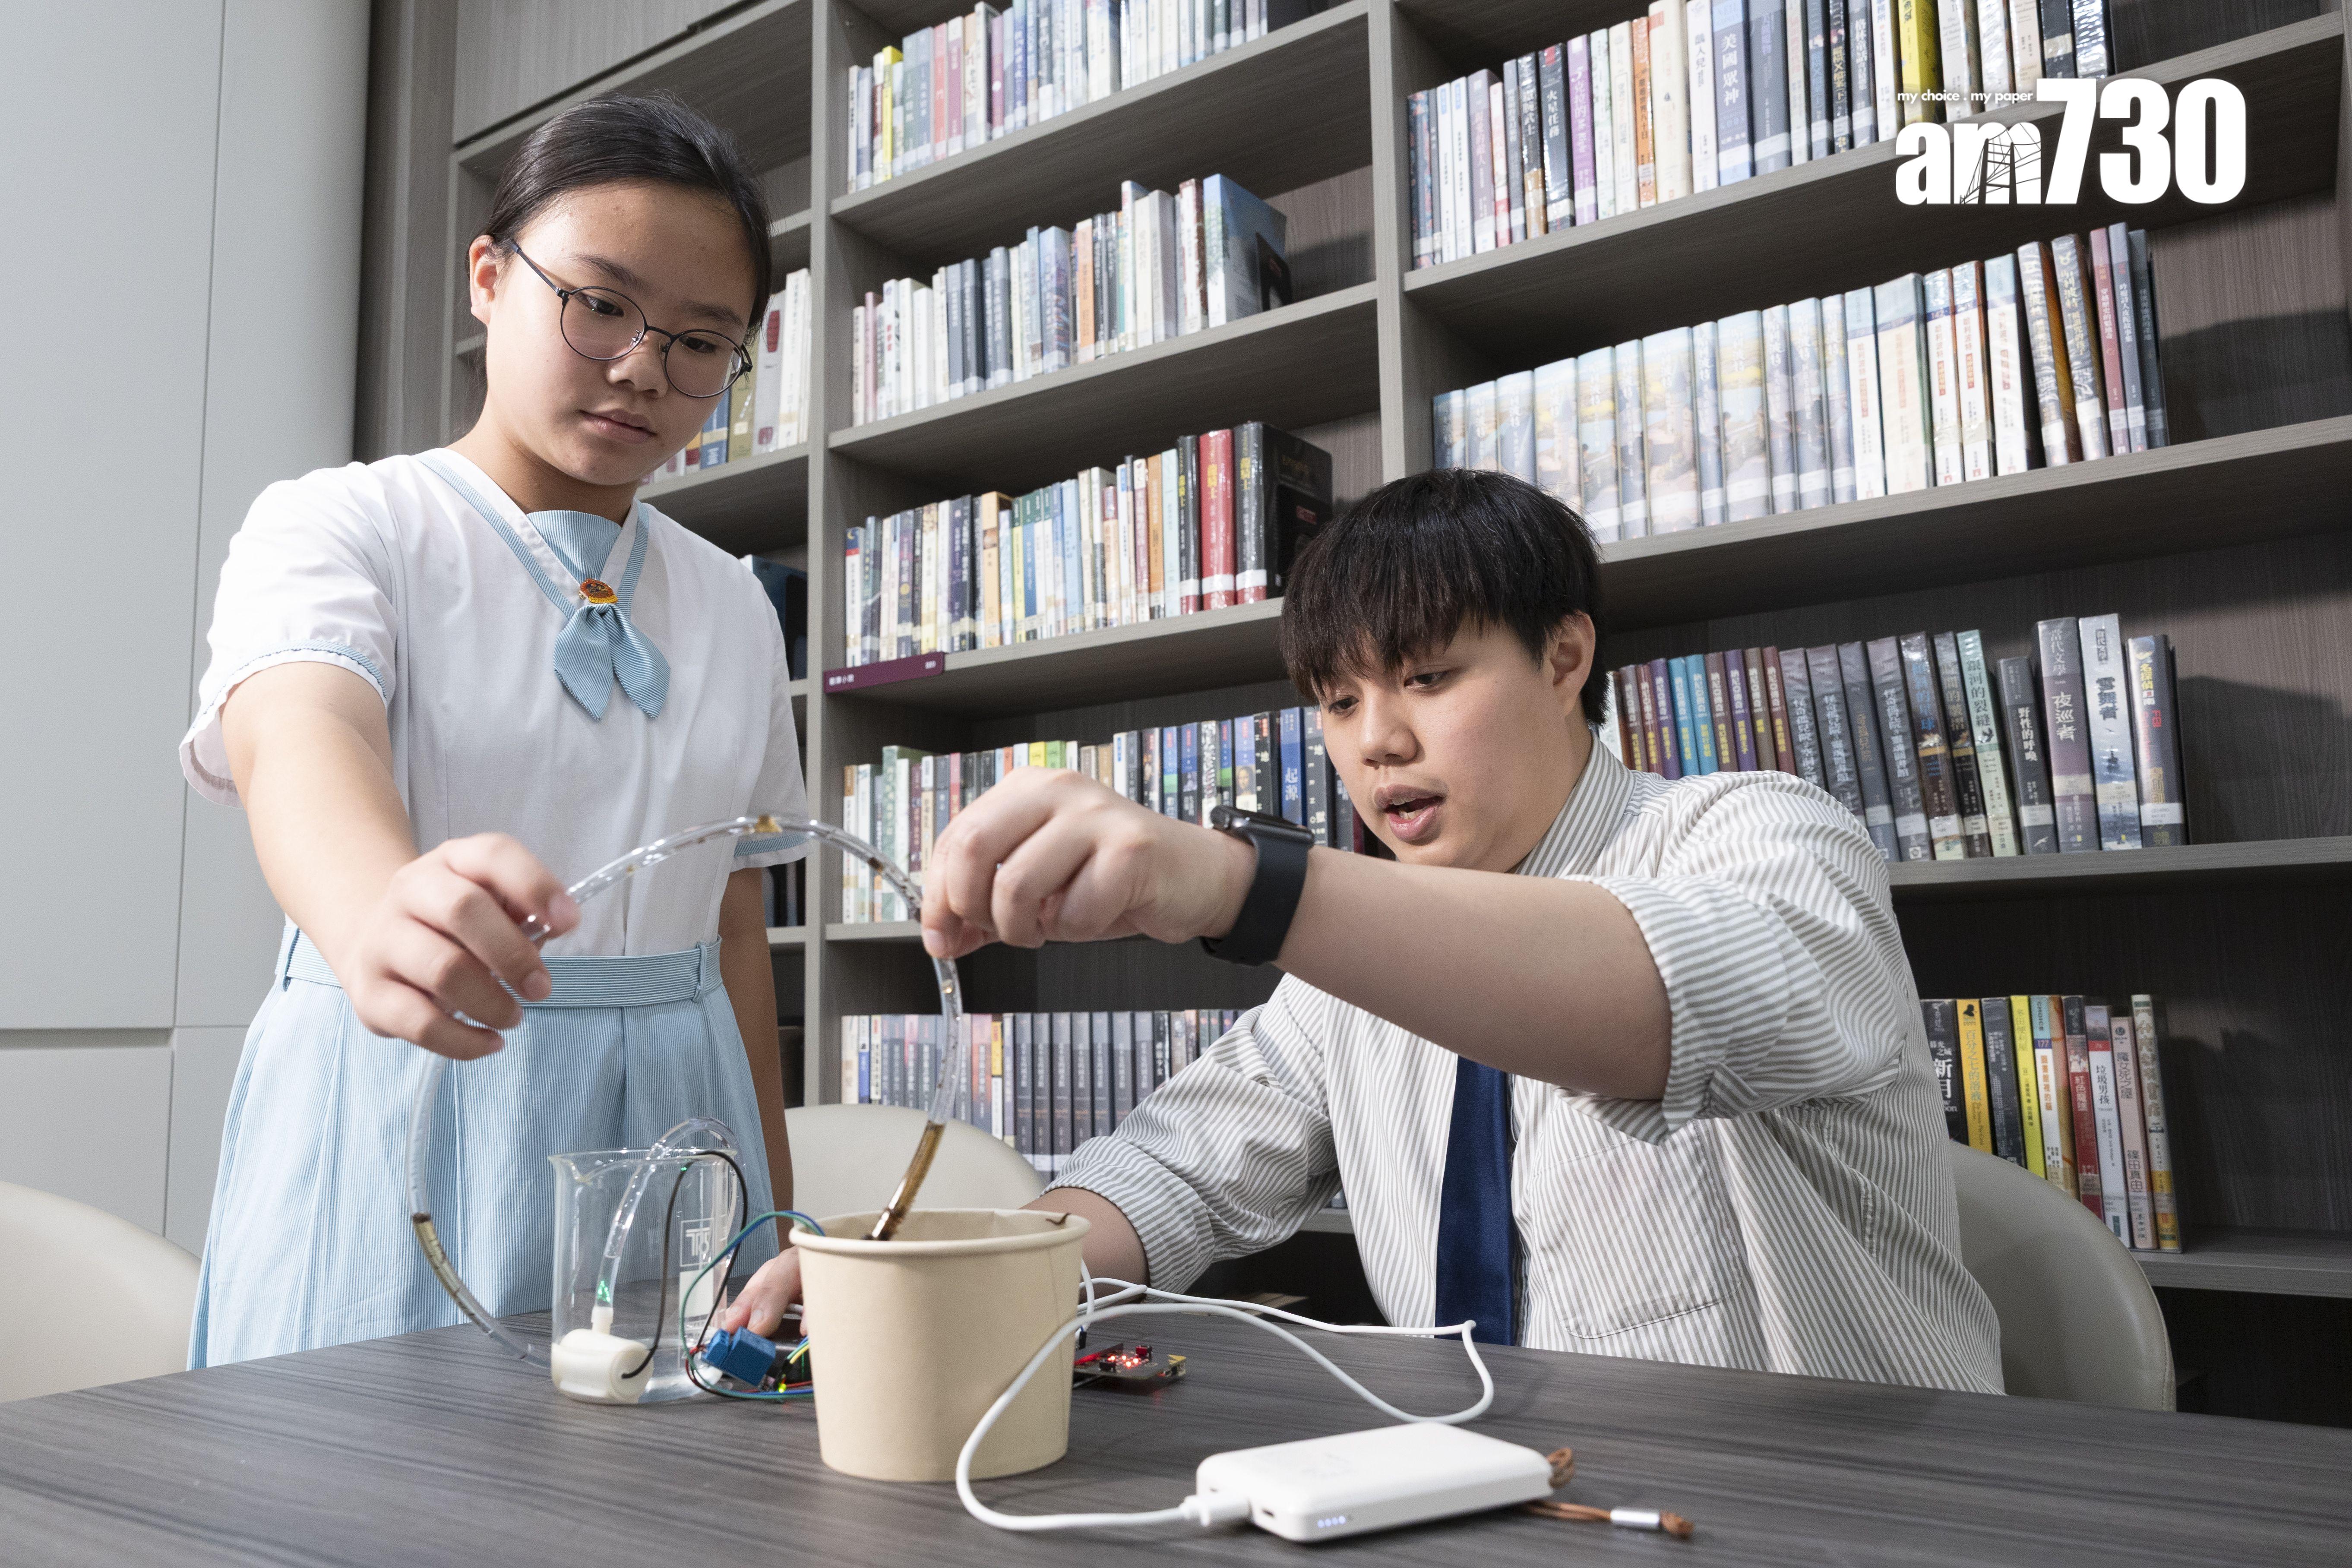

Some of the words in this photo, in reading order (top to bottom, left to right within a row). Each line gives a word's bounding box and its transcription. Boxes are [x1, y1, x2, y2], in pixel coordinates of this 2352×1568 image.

[1722, 34, 1739, 105] 美國眾神
[1546, 90, 1560, 138] 火星任務
[1965, 661, 1990, 727] 銀河的裂縫
[2052, 692, 2076, 743] 夜巡者
[2017, 707, 2037, 762] 野性的呼喚
[2152, 709, 2162, 728] FBI
[1285, 767, 1299, 801] 起源
[1934, 1058, 1953, 1099] 新月
[1966, 1029, 1982, 1100] 百分之七的溶液
[2096, 1065, 2110, 1105] 垃圾男孩
[2127, 1150, 2143, 1193] 篠田真由
